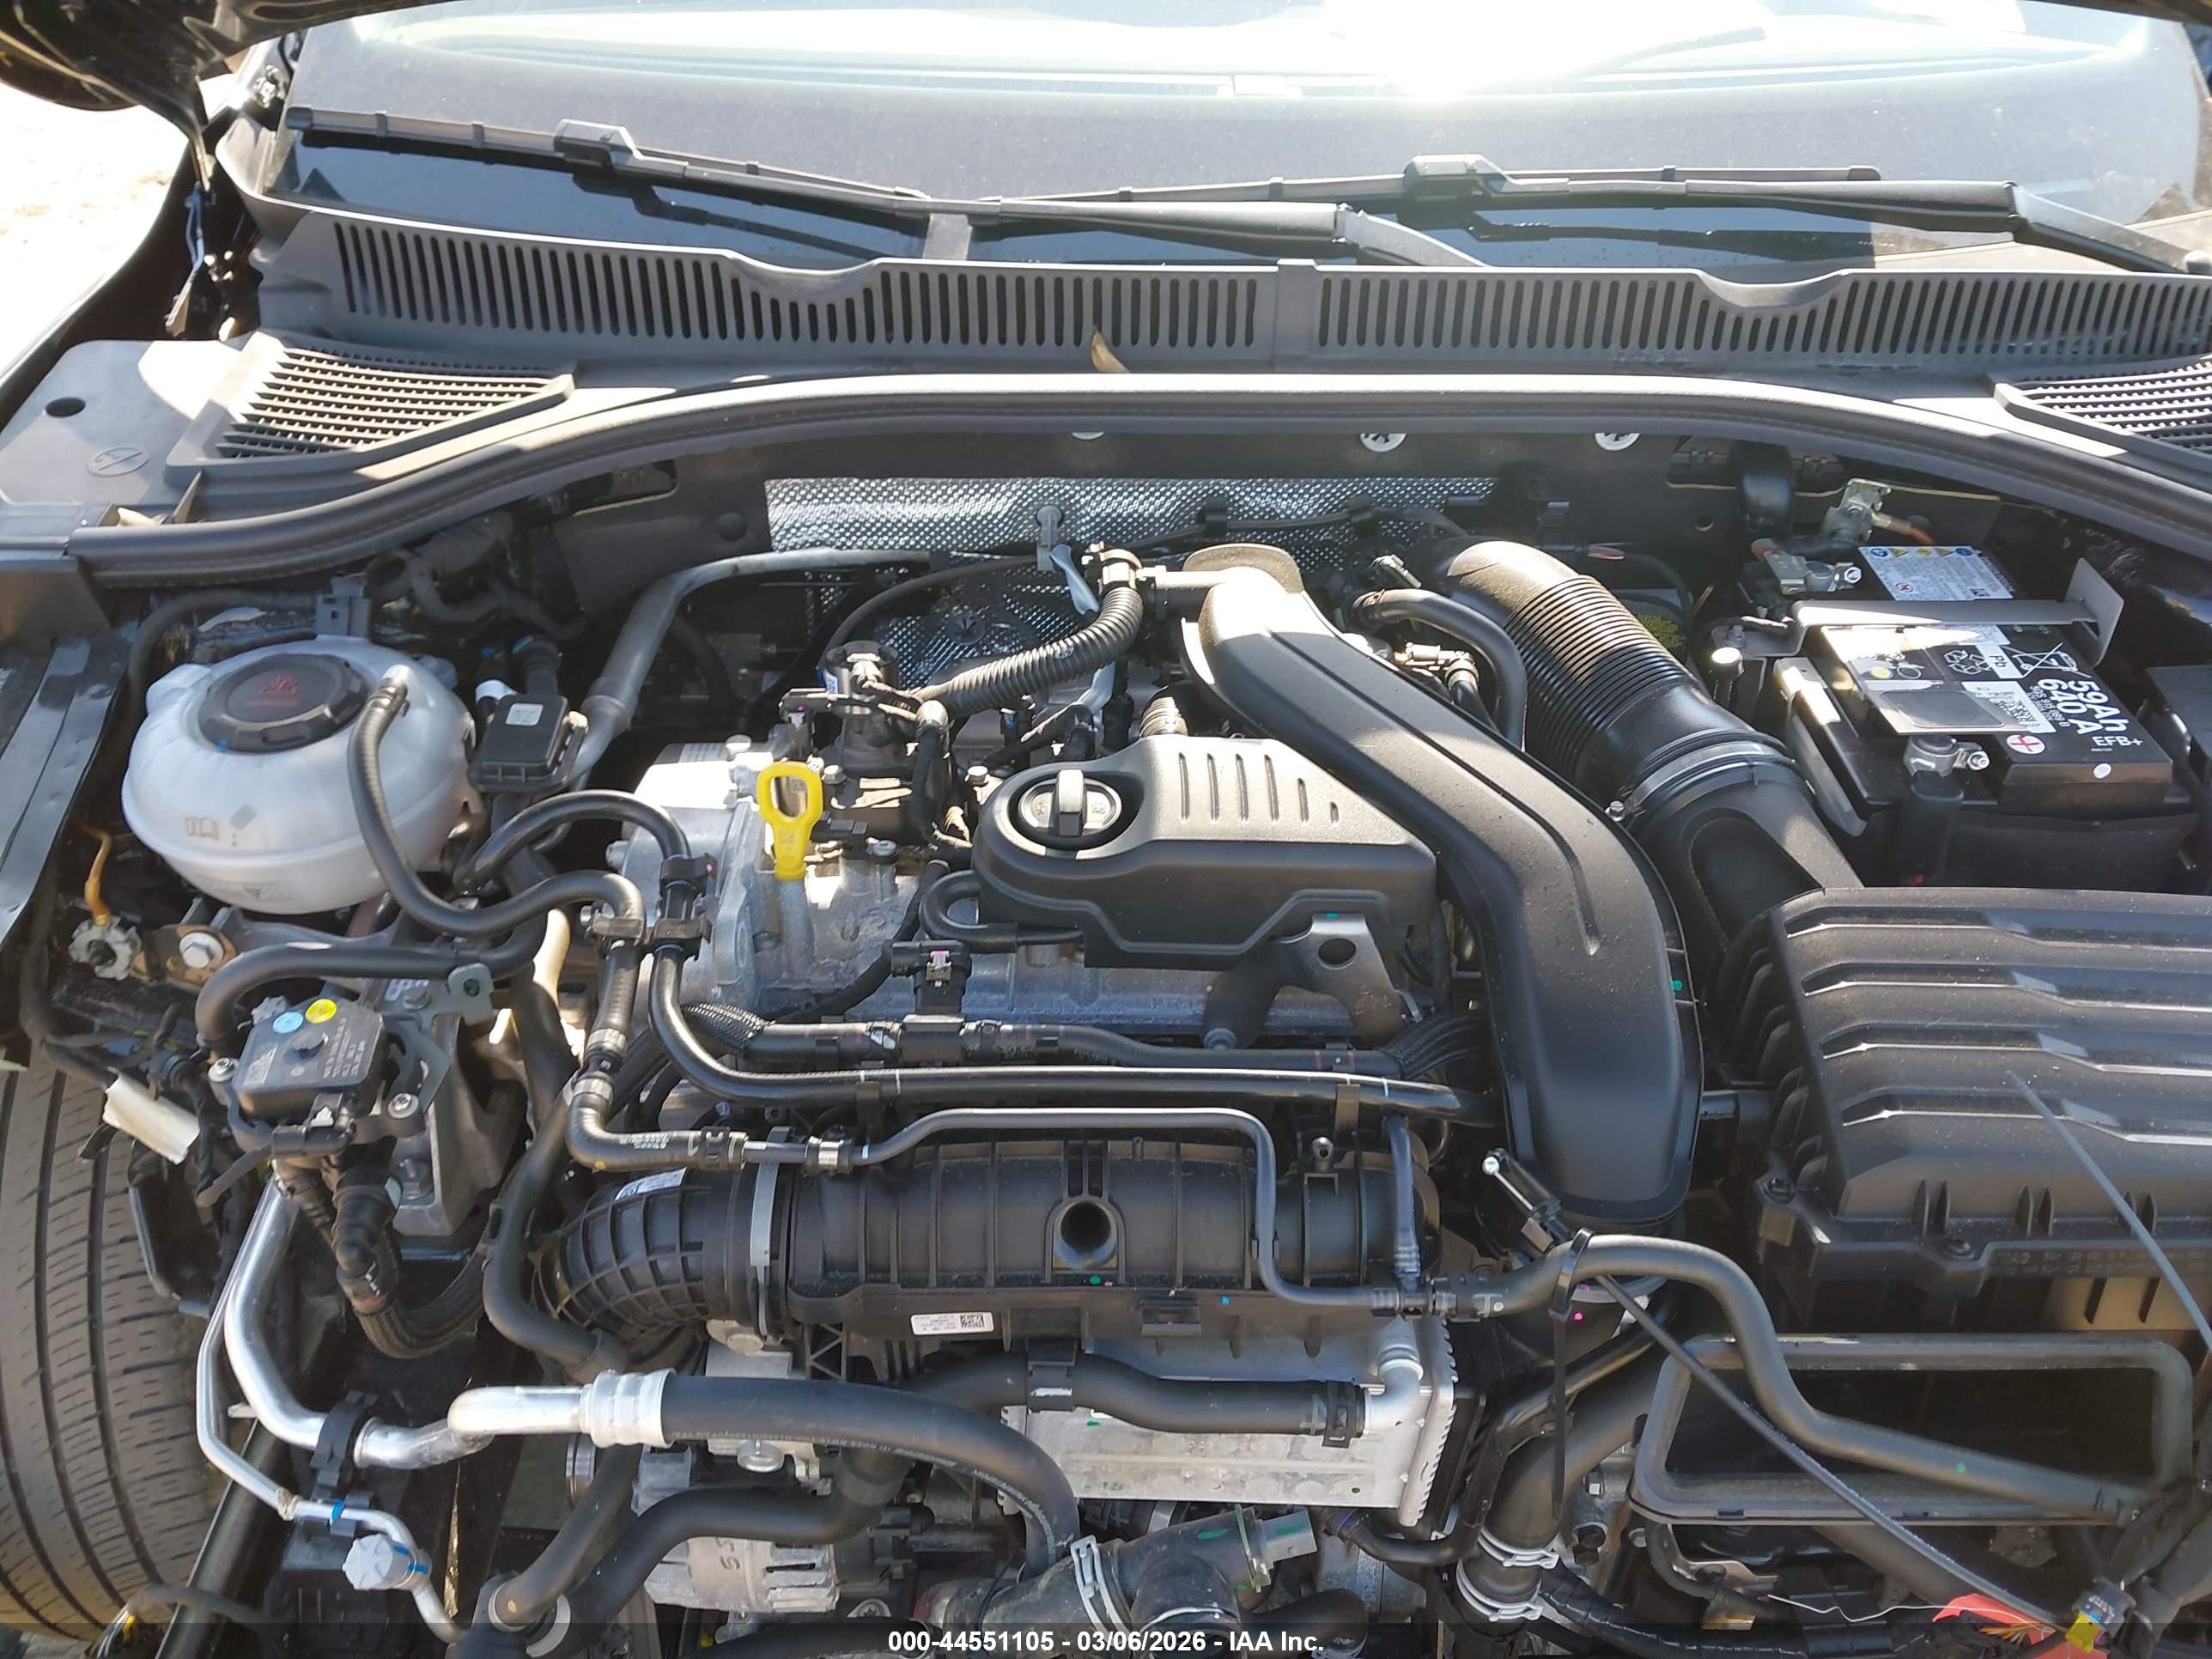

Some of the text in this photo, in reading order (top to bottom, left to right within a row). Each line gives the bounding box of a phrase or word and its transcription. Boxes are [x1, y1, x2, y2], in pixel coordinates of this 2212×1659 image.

[1989, 654, 2008, 669] Pb
[2038, 678, 2088, 714] 640
[2068, 718, 2104, 735] A
[2068, 680, 2130, 732] 59Ah
[2092, 736, 2144, 746] EFB+
